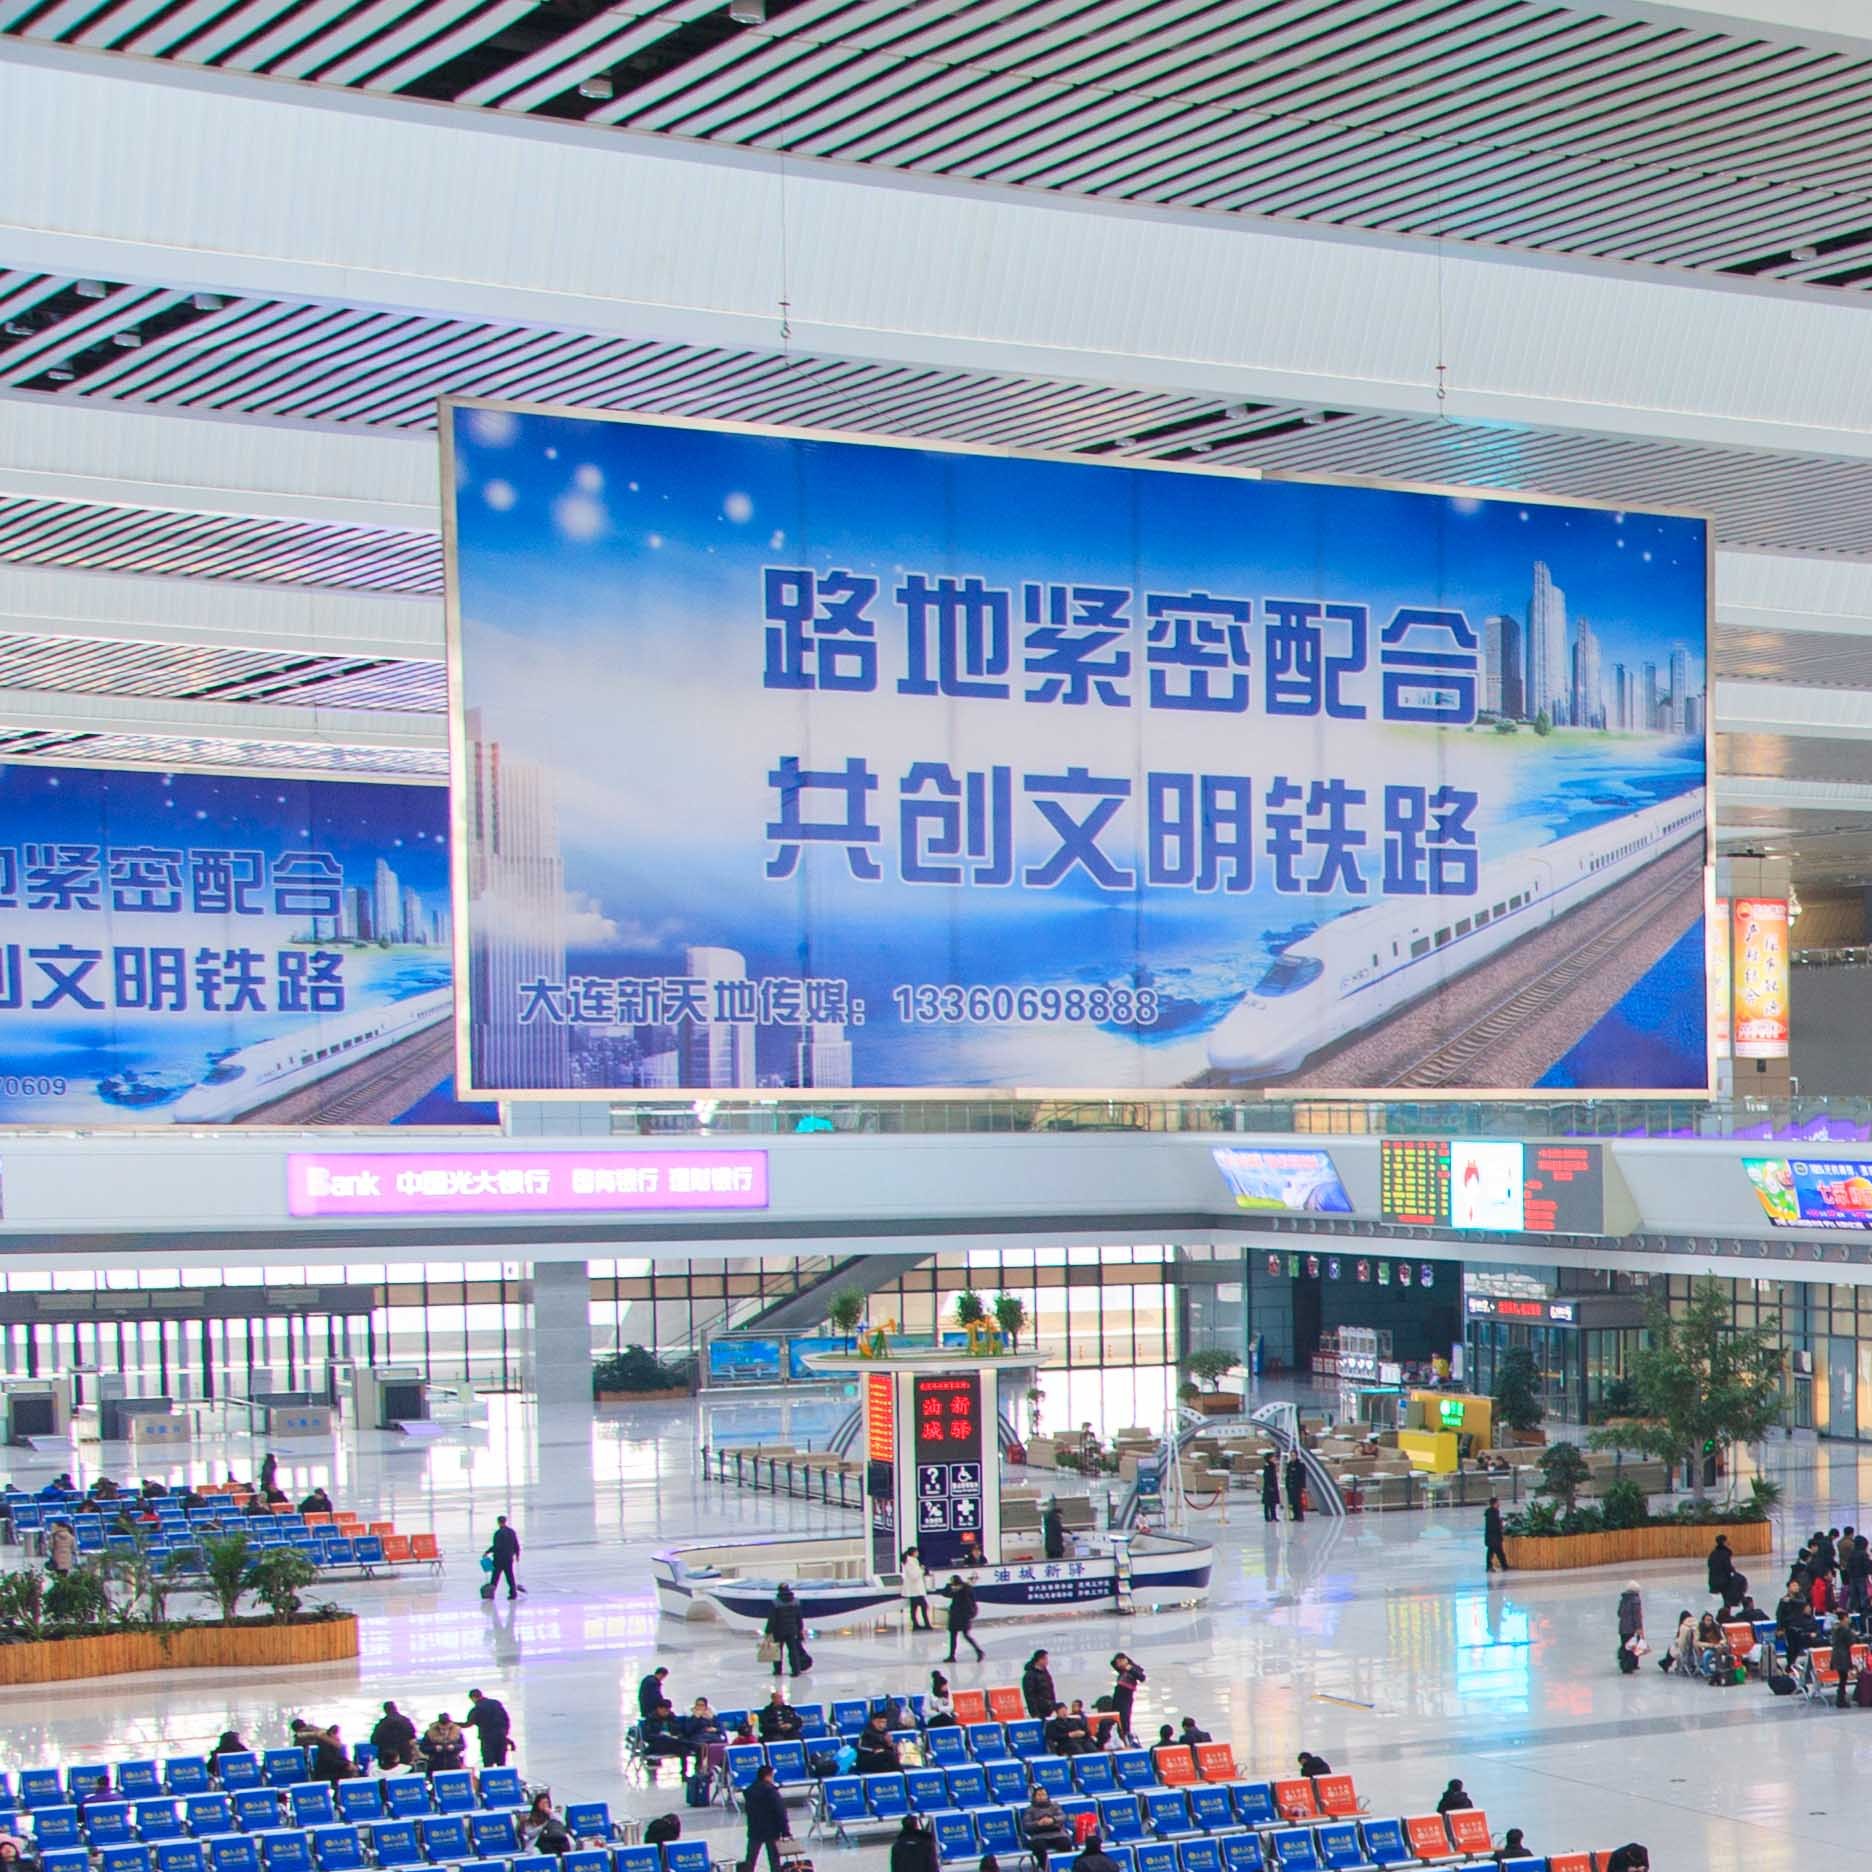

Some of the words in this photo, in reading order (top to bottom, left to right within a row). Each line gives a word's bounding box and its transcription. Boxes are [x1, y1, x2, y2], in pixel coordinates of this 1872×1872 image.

[760, 565, 1483, 726] 路地紧密配合
[0, 843, 344, 916] 紧密配合
[764, 754, 1482, 898] 共创文明铁路
[893, 983, 1159, 1025] 13360698888
